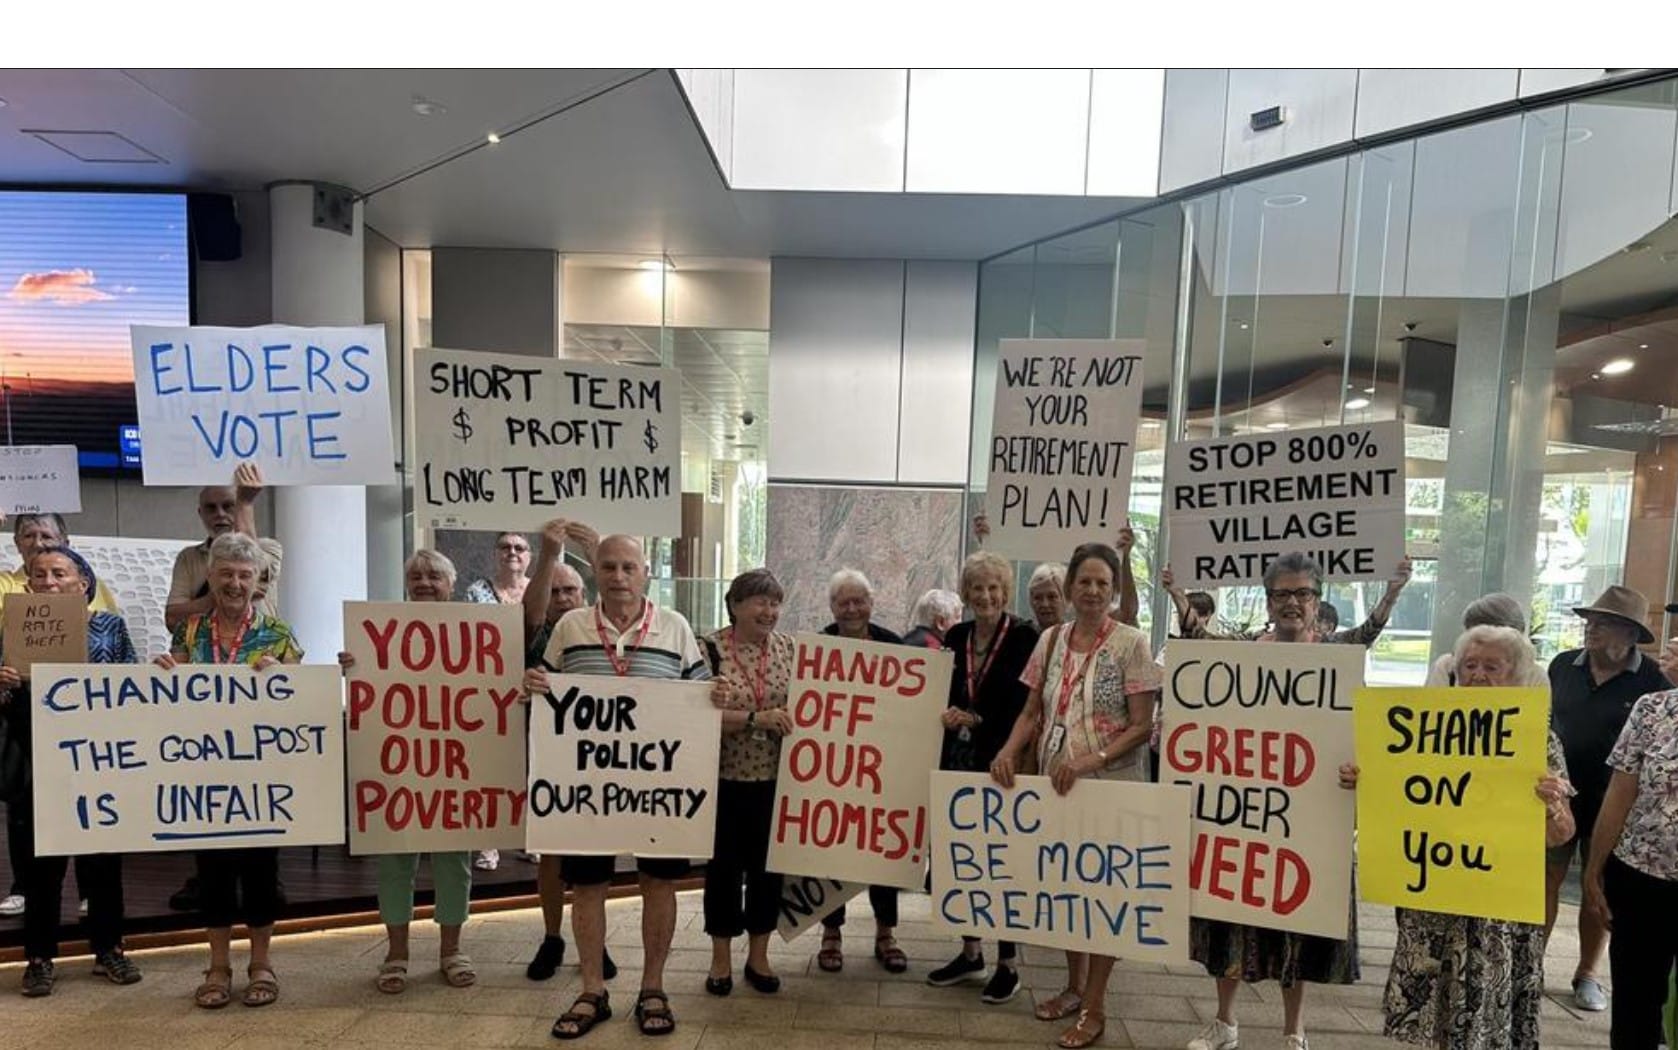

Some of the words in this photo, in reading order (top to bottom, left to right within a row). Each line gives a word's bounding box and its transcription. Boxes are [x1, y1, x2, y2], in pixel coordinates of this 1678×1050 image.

[150, 343, 370, 395] ELDERS
[430, 362, 542, 402] SHORT
[564, 371, 661, 413] TERM
[1003, 355, 1076, 388] WE'RE
[1083, 356, 1142, 388] NOT
[453, 407, 472, 443] $
[506, 417, 622, 449] PROFIT
[644, 419, 659, 453] $
[1025, 394, 1088, 427] YOUR
[192, 411, 346, 459] VOTE
[991, 436, 1128, 479] RETIREMENT
[1189, 440, 1276, 472] STOP
[1288, 431, 1378, 464] 800%
[424, 463, 494, 506] LONG
[502, 466, 586, 505] TERM
[600, 466, 670, 501] HARM
[1001, 484, 1108, 529] PLAN!
[1175, 469, 1397, 510] RETIREMENT
[1208, 510, 1357, 544] VILLAGE
[23, 619, 64, 632] RATE
[26, 604, 50, 618] NO
[362, 619, 504, 675] YOUR
[797, 644, 926, 696] HANDS
[43, 674, 294, 711] CHANGING
[350, 680, 519, 735] POLICY
[1172, 659, 1353, 711] COUNCIL
[544, 686, 637, 735] YOUR
[794, 690, 876, 737] OFF
[1386, 705, 1520, 758] SHAME
[59, 739, 147, 770] THE
[381, 735, 469, 779] OUR
[577, 739, 681, 772] POLICY
[789, 739, 882, 794] OUR
[1166, 722, 1315, 787] GREED
[77, 793, 119, 830] IS
[157, 783, 293, 823] UNFAIR
[356, 781, 526, 832] POVERTY
[531, 779, 596, 817] OUR
[603, 782, 707, 819] POVERTY
[949, 786, 1041, 834] CRC
[1174, 780, 1290, 838] LDER
[1405, 771, 1471, 807] ON
[776, 795, 925, 863] HOMES!
[951, 843, 1015, 883] BE
[1038, 841, 1172, 889] MORE
[780, 877, 842, 928] NO
[942, 888, 1168, 945] CREATIVE
